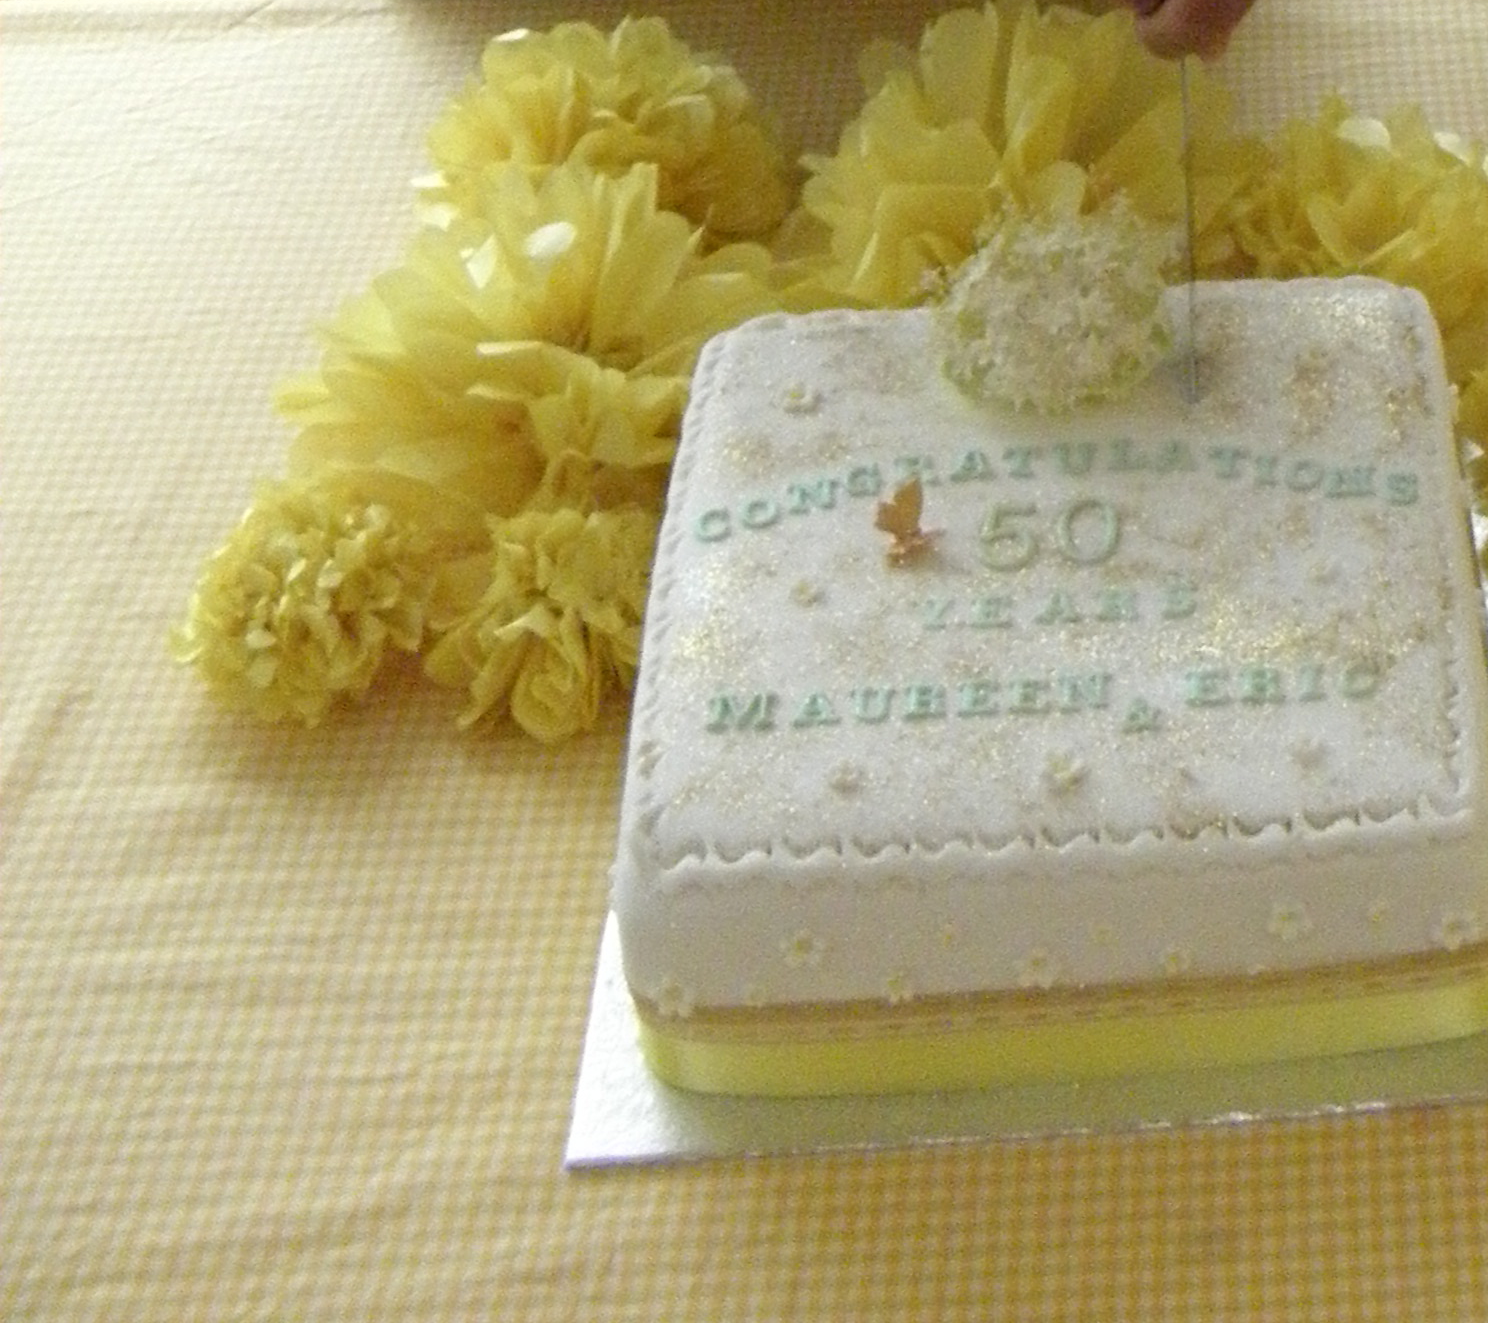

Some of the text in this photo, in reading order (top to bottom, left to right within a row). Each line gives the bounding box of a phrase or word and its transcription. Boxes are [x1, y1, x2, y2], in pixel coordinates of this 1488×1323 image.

[694, 438, 1419, 545] CONGRATULATIONS
[976, 494, 1127, 575] 50
[914, 587, 1202, 631] YEARS
[704, 668, 1111, 736] MAUREEN
[1184, 660, 1384, 709] ERIC
